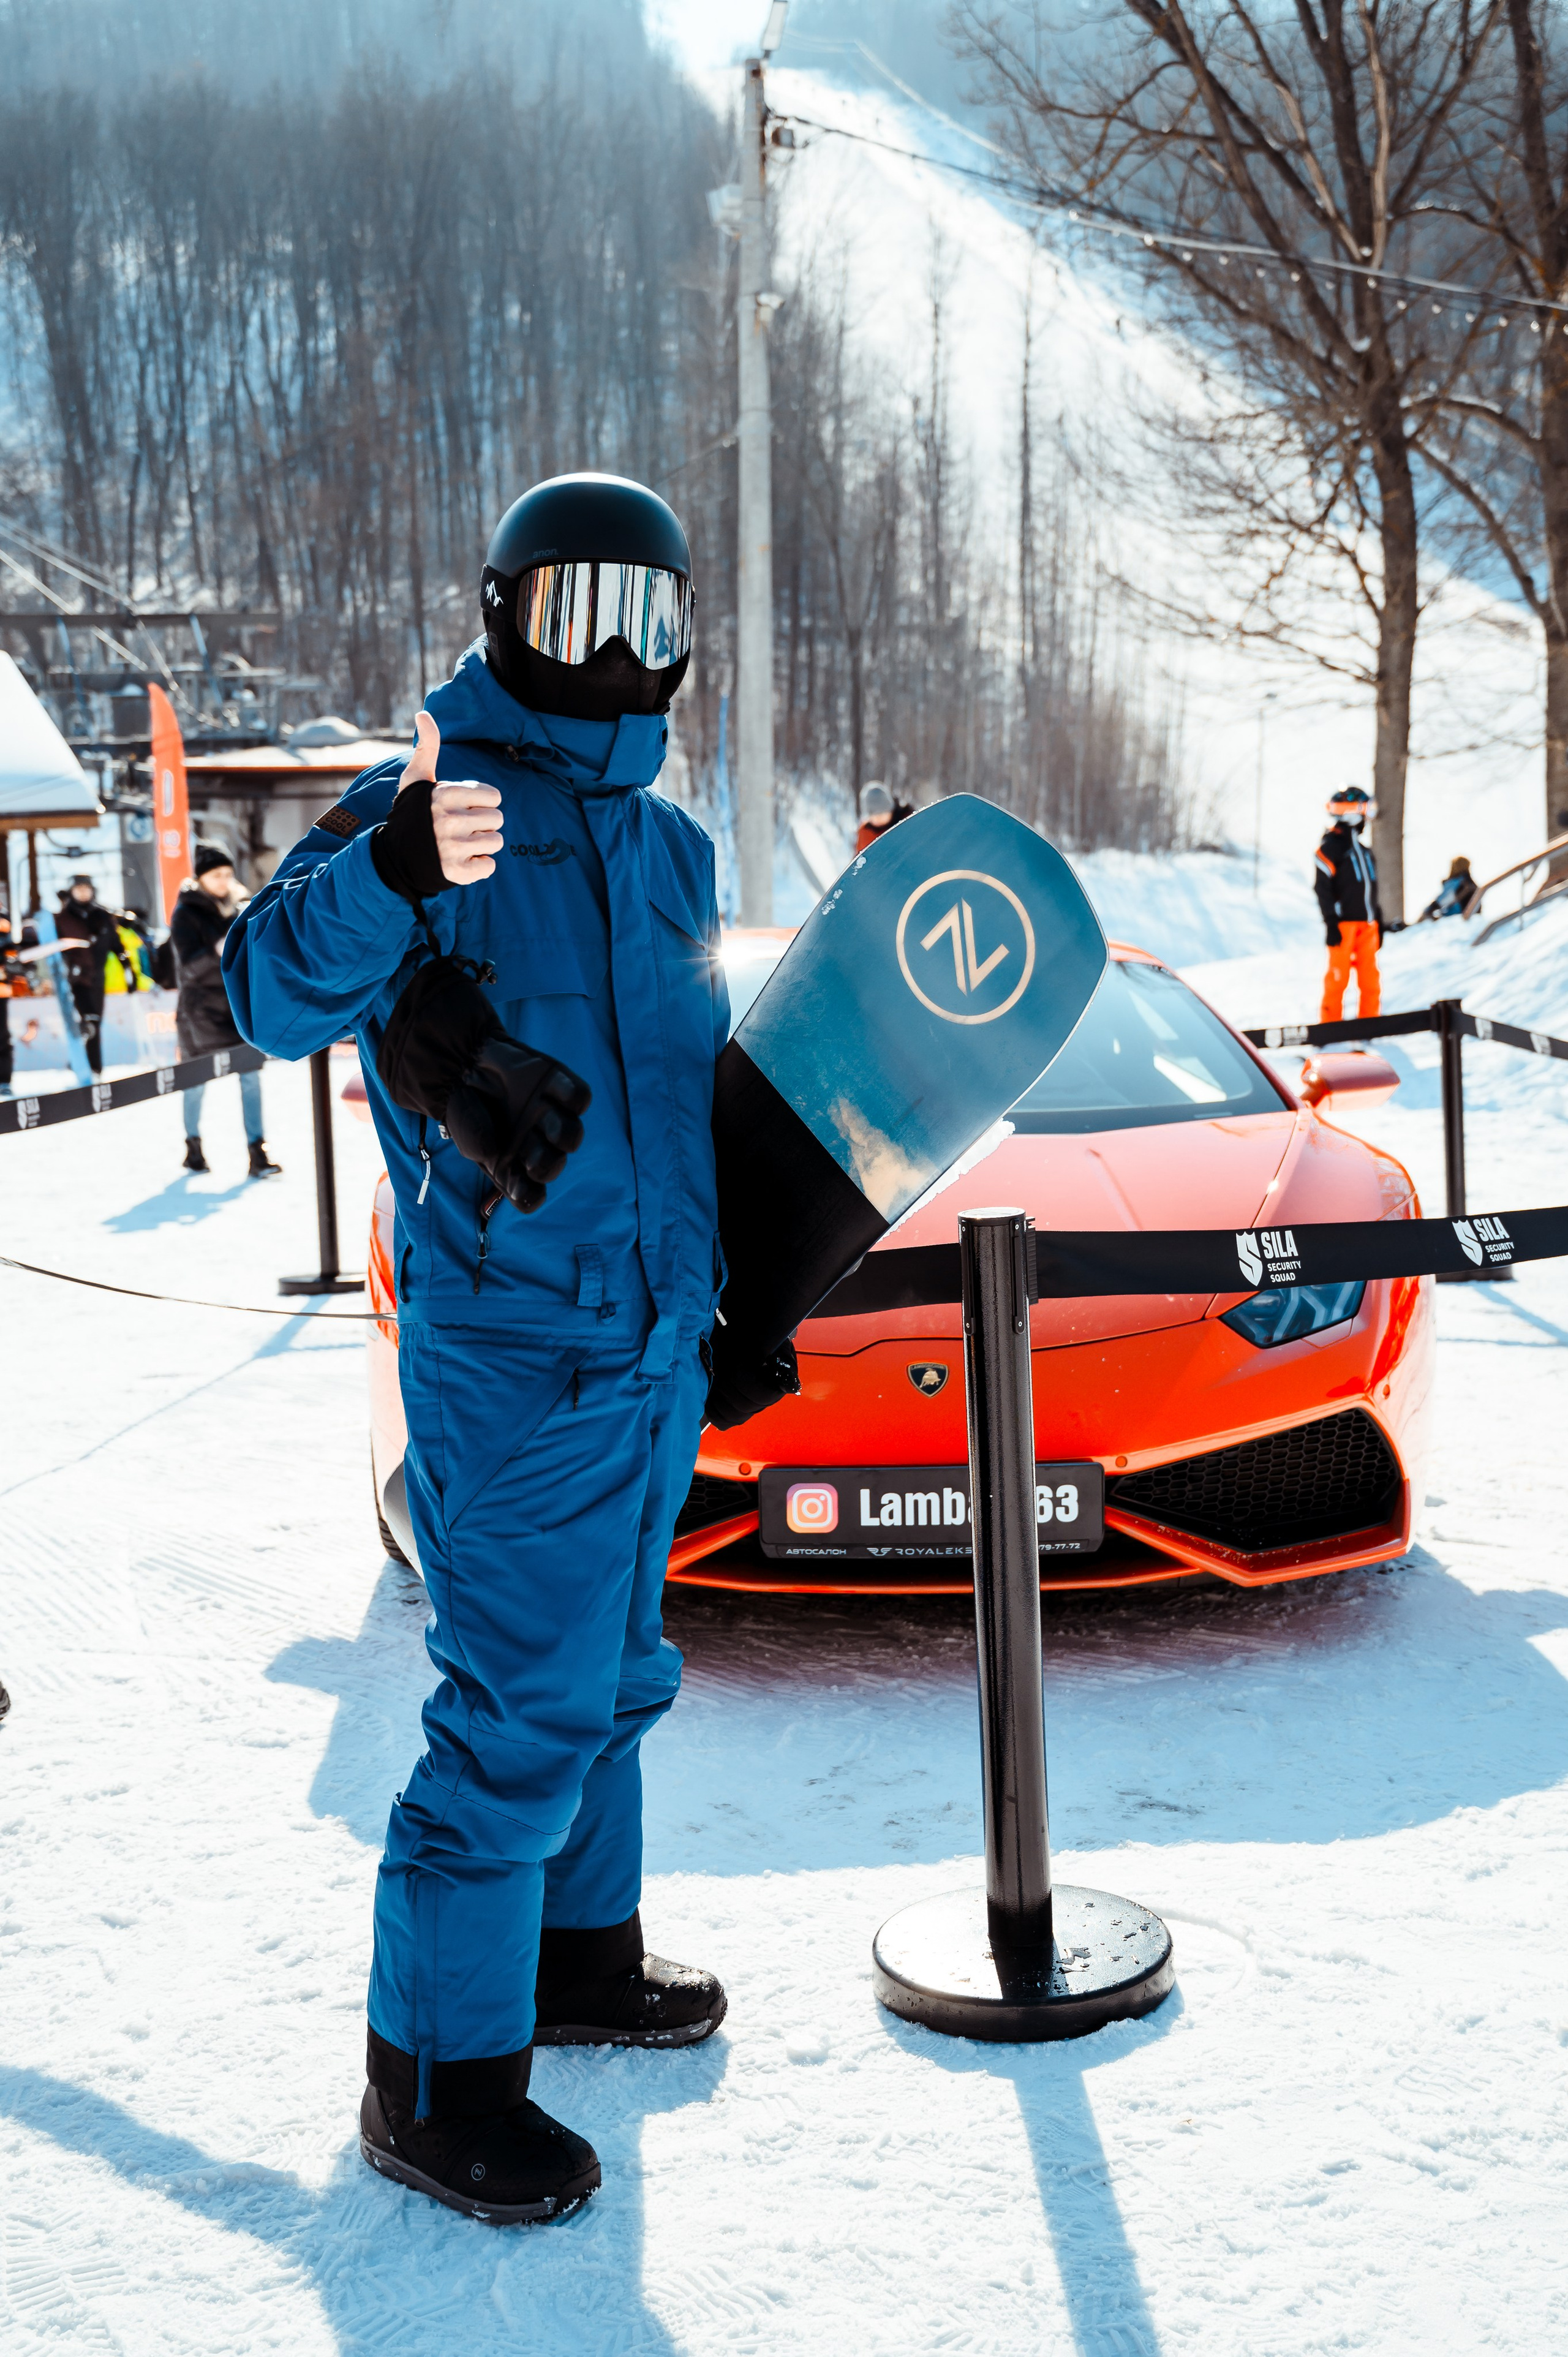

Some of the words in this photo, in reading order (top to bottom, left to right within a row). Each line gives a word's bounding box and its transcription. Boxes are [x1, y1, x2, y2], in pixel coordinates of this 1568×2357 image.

[325, 816, 347, 832] COOL
[1473, 1216, 1510, 1242] SILA
[1261, 1230, 1298, 1259] SILA
[1485, 1242, 1515, 1253] SECURITY
[1490, 1252, 1512, 1262] SQUAD
[1267, 1261, 1302, 1272] SECURITY
[1270, 1272, 1296, 1283] SQUAD
[860, 1487, 971, 1526] Lamb
